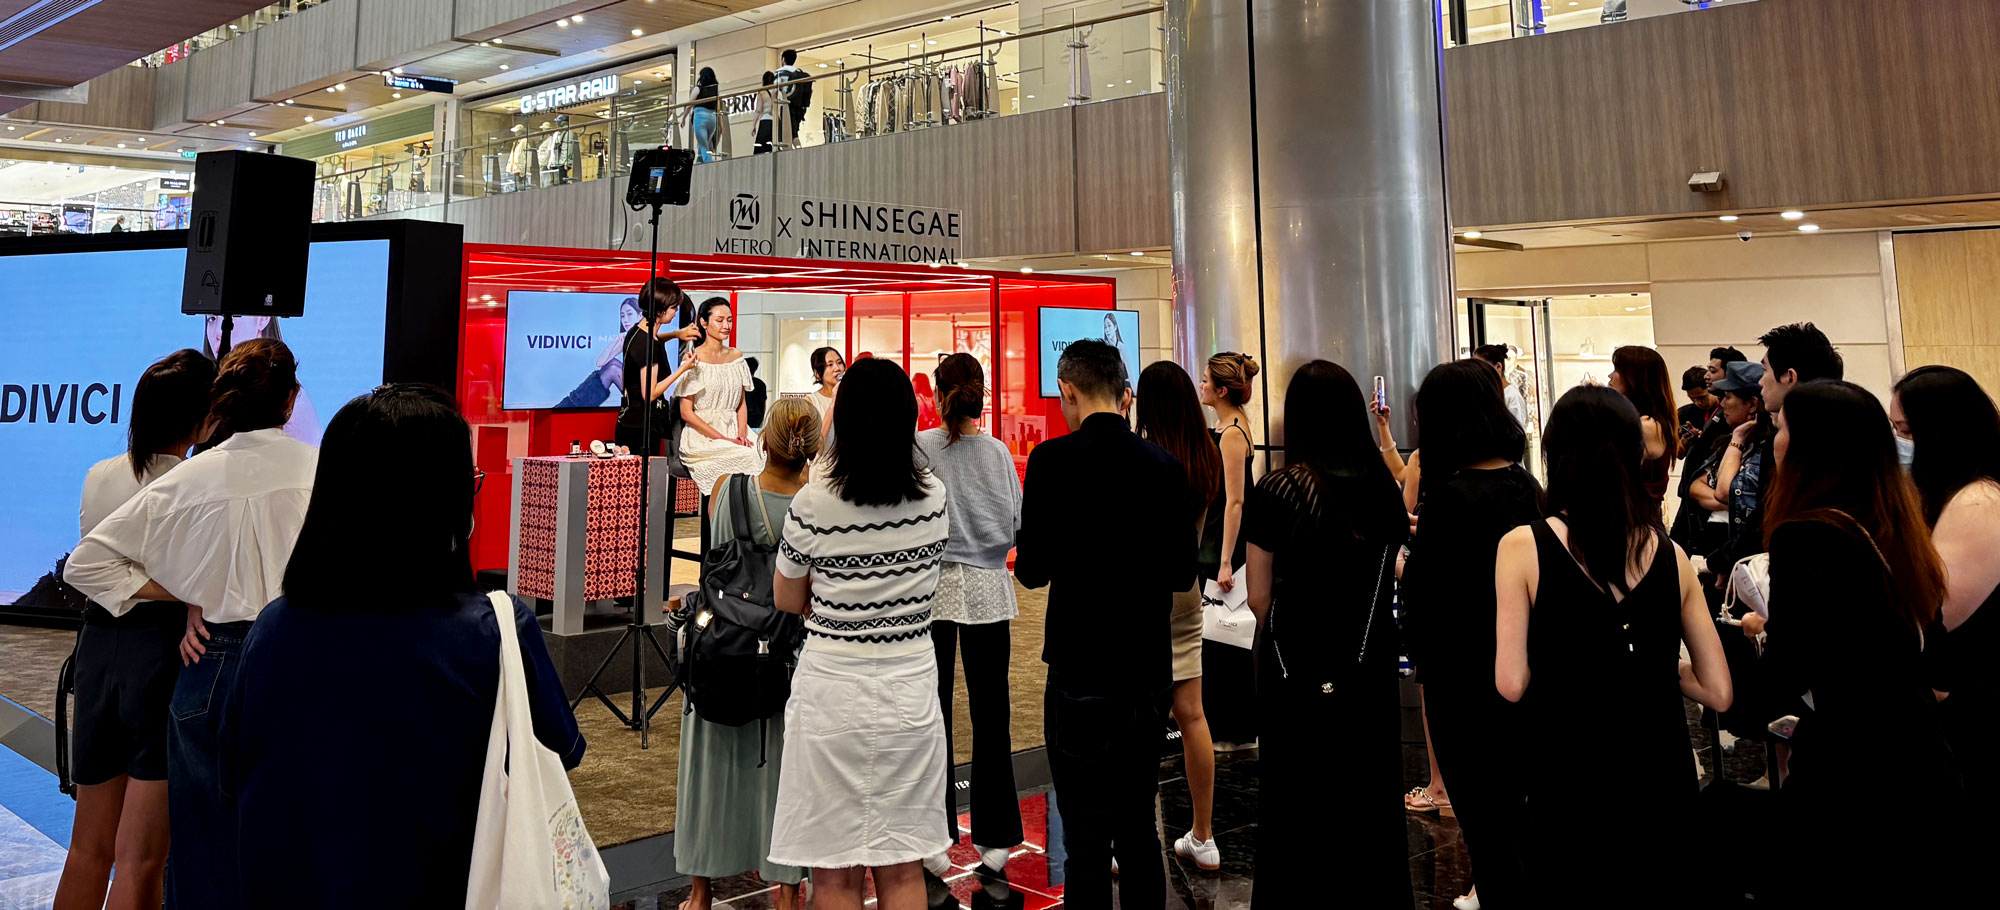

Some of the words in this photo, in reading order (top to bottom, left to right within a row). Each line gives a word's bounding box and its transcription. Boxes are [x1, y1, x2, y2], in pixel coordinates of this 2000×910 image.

[578, 74, 617, 100] RAW
[715, 237, 773, 255] METRO
[801, 200, 960, 238] SHINSEGAE
[801, 237, 959, 265] INTERNATIONAL
[527, 335, 592, 349] VIDIVICI
[0, 382, 121, 424] DIVICI
